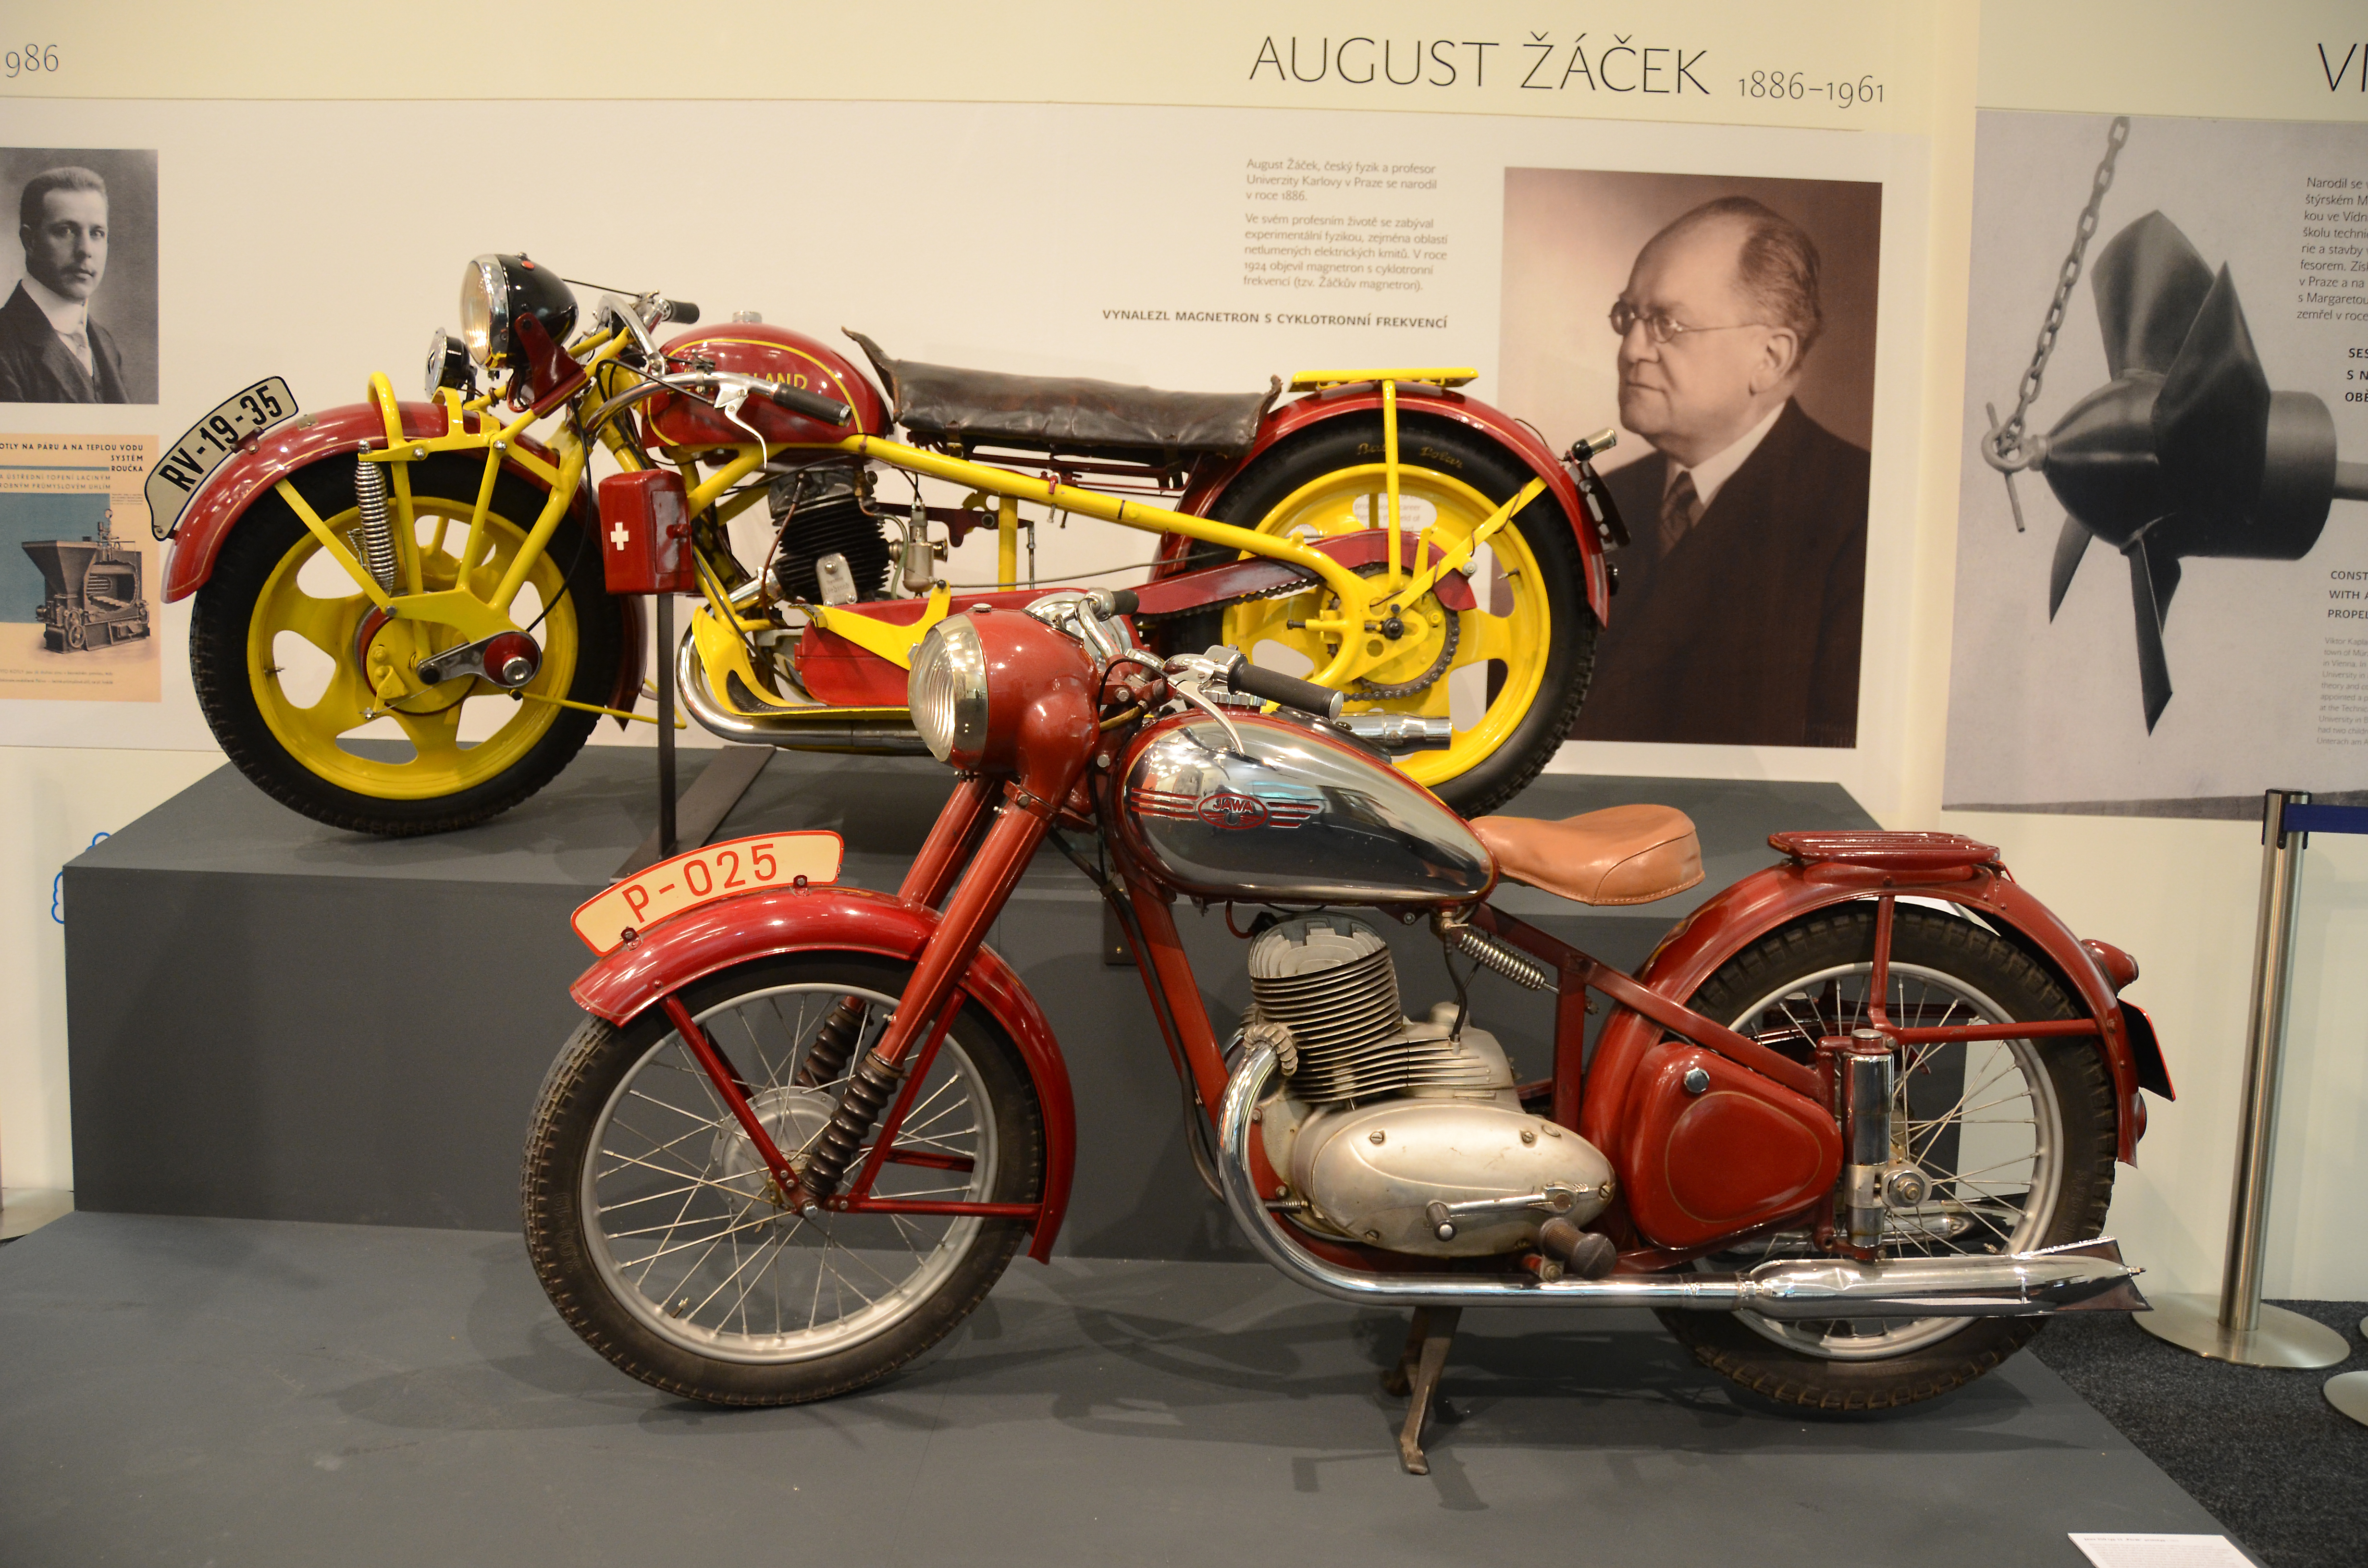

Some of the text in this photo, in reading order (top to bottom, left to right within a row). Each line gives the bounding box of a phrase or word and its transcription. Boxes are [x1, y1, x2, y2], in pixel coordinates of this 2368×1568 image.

[1249, 36, 1499, 87] AUGUST
[1520, 31, 1711, 95] ŽÁČEK
[1247, 159, 1283, 171] August
[1287, 157, 1320, 172] Žáček,
[1324, 160, 1353, 173] český
[1356, 161, 1379, 173] fyzik
[1392, 163, 1436, 175] profesor
[1247, 174, 1298, 187] Univerzity
[1302, 175, 1342, 188] Karlovy
[1355, 177, 1383, 188] Praze
[1386, 180, 1398, 188] se
[1401, 180, 1437, 189] narodil
[2307, 177, 2363, 189] Narodil se
[1282, 190, 1307, 201] 1886.
[2305, 194, 2354, 208] štýrském
[1246, 213, 1259, 223] Ve
[1262, 214, 1289, 224] svém
[1292, 215, 1344, 226] profesním
[1347, 216, 1378, 226] životě
[1395, 218, 1434, 231] zabýval
[2304, 210, 2324, 221] kou
[2327, 213, 2340, 222] ve
[1245, 229, 1448, 245] experimentální fyzikou, zejména oblastí
[2303, 226, 2330, 238] školu
[1245, 245, 1311, 258] netlumených
[1315, 246, 1376, 259] elektrických
[1379, 248, 1410, 259] kmitů.
[1413, 249, 1421, 258] V
[2301, 243, 2364, 257] rie a stavby
[1245, 260, 1434, 276] 1924 objevil magnetron s cyklotronní
[2300, 259, 2346, 271] fesorem.
[1244, 274, 1424, 293] frekvencí (tzv. Žáčkův magnetron).
[2308, 276, 2339, 288] Praze
[2341, 280, 2348, 288] a
[2351, 280, 2365, 288] na
[2298, 294, 2303, 303] s
[1103, 309, 1448, 329] VYNALEZL MAGNETRON S CYKLOTRONNÍ FREKVENCÍ
[2296, 309, 2332, 320] zemřel
[2346, 370, 2354, 380] S
[159, 385, 283, 493] RV-19-35
[37, 442, 59, 450] PÁRU
[111, 453, 143, 462] SYSTÉM
[111, 464, 143, 472] ROUČKA
[2329, 590, 2360, 600] WITH
[2322, 671, 2357, 680] University
[2321, 682, 2344, 690] theory
[2319, 715, 2353, 724] University
[1212, 798, 1254, 814] JAWA
[622, 844, 777, 923] P-025
